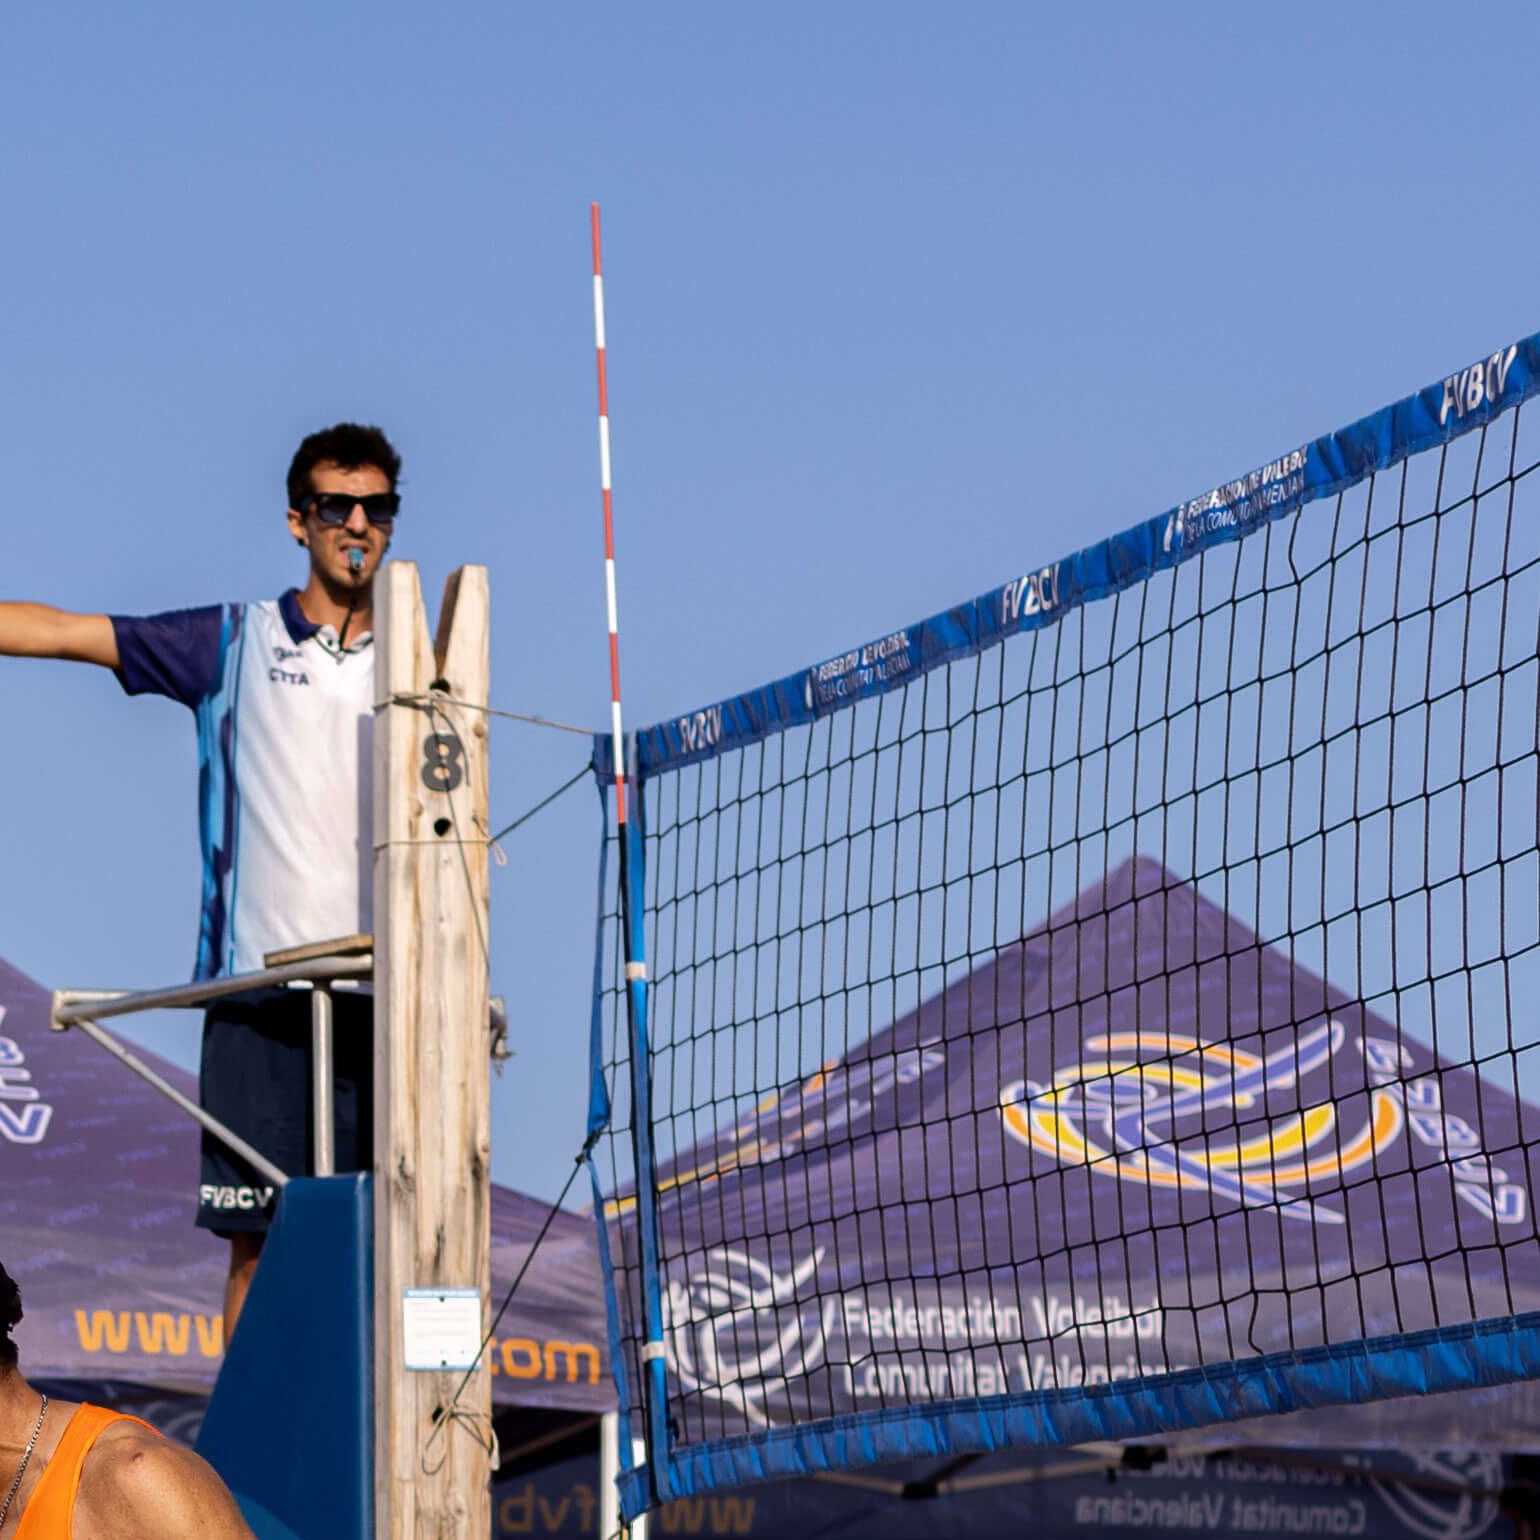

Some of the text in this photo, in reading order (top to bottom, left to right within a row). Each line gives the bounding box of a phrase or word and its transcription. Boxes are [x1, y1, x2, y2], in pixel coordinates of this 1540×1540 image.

[1440, 343, 1518, 425] FVBCV
[421, 734, 463, 792] 8
[200, 1184, 274, 1209] FVBCV
[844, 1297, 1021, 1338] Federación
